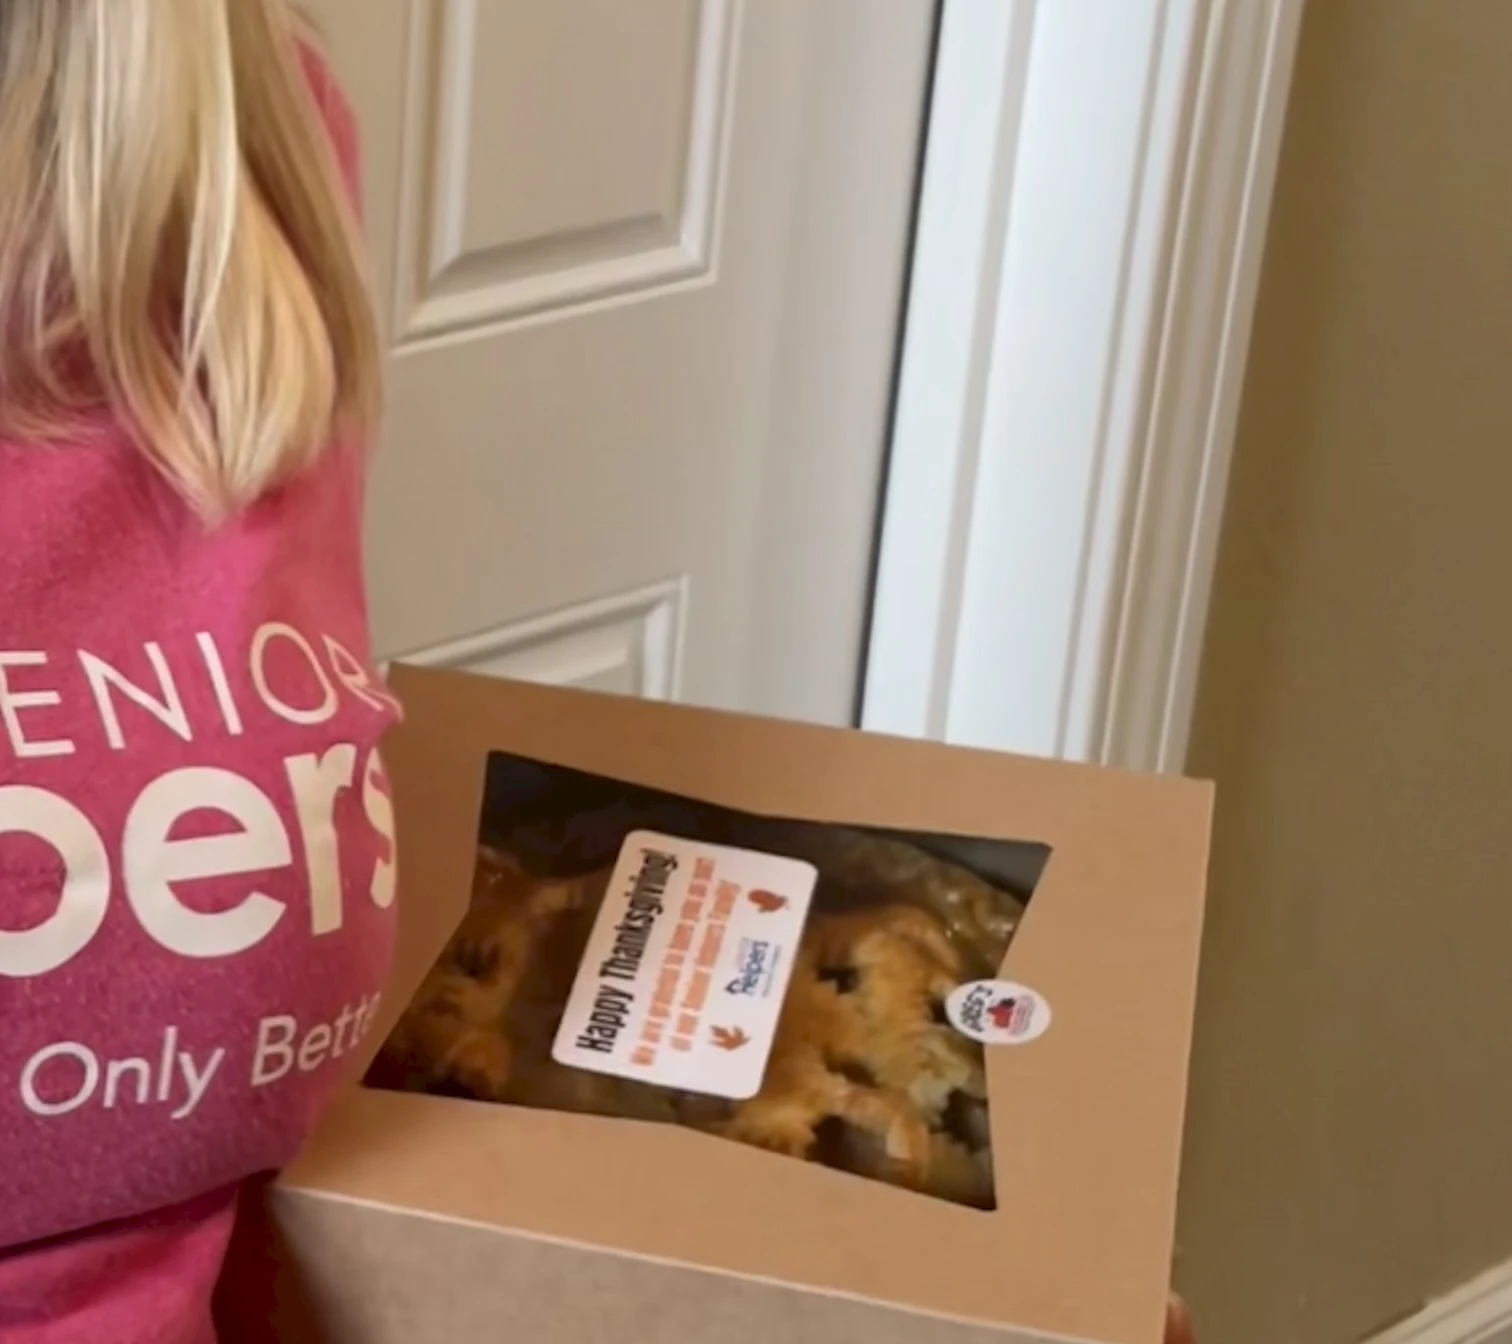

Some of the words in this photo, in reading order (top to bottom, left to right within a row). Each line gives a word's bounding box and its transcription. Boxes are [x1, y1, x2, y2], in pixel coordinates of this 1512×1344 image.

[598, 847, 679, 981] Thanksgiving!
[575, 984, 635, 1054] Happy
[19, 1026, 225, 1120] Only
